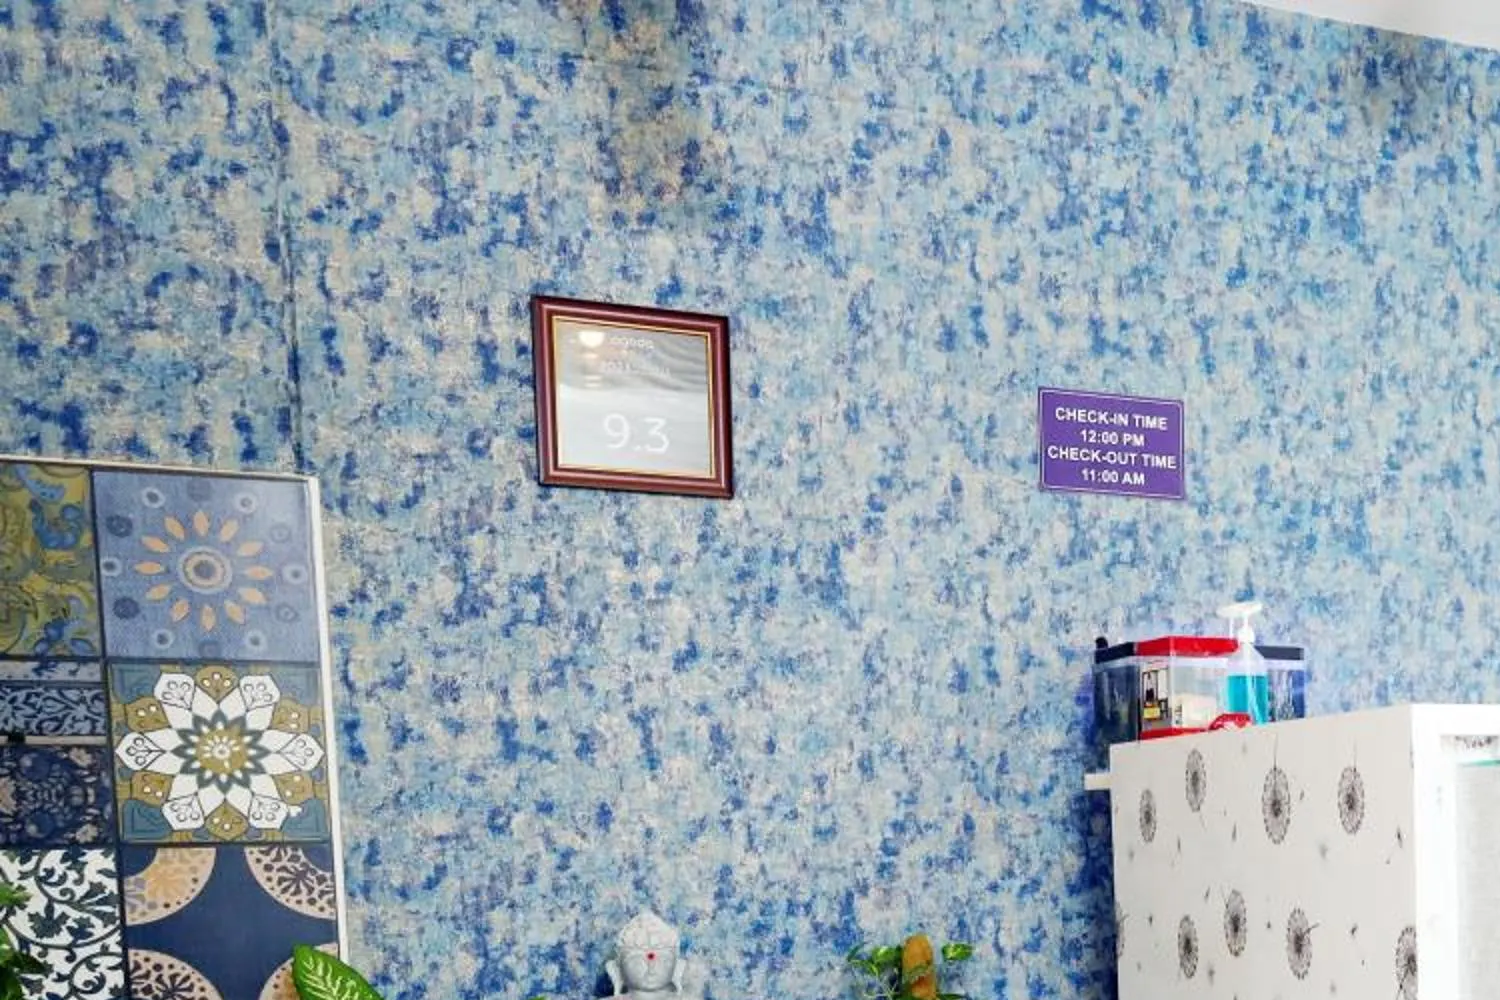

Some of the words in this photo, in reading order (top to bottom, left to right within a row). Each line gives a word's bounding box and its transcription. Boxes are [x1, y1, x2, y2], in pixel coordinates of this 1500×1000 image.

[1055, 407, 1128, 426] CHECK-IN
[1133, 414, 1168, 430] TIME
[603, 412, 671, 454] 9.3
[1080, 429, 1118, 444] 12:00
[1123, 433, 1144, 446] PM
[1047, 446, 1138, 464] CHECK-OUT
[1143, 454, 1177, 469] TIME
[1081, 468, 1119, 483] 11:00
[1121, 471, 1145, 485] AM
